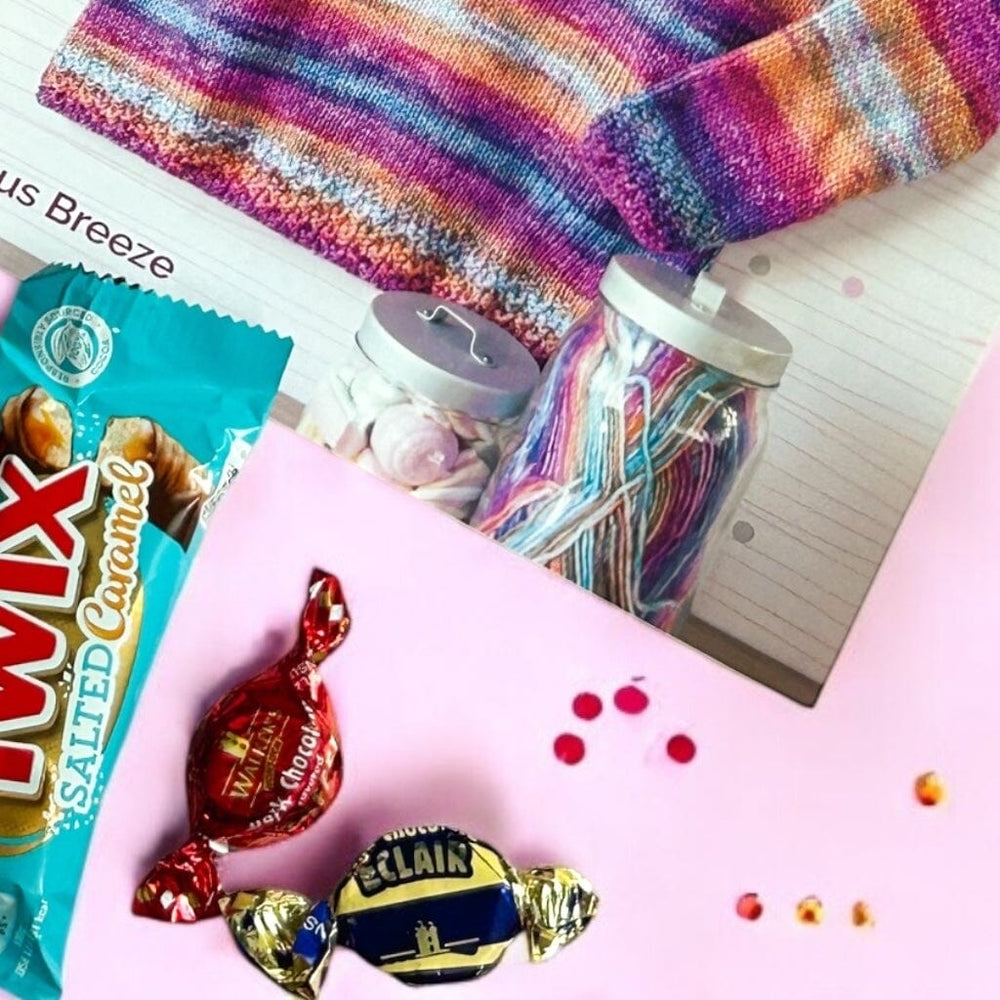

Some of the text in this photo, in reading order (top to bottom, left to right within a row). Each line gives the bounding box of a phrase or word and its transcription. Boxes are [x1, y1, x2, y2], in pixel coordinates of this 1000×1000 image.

[43, 191, 176, 280] Breeze
[58, 459, 155, 812] SALTED Caramel
